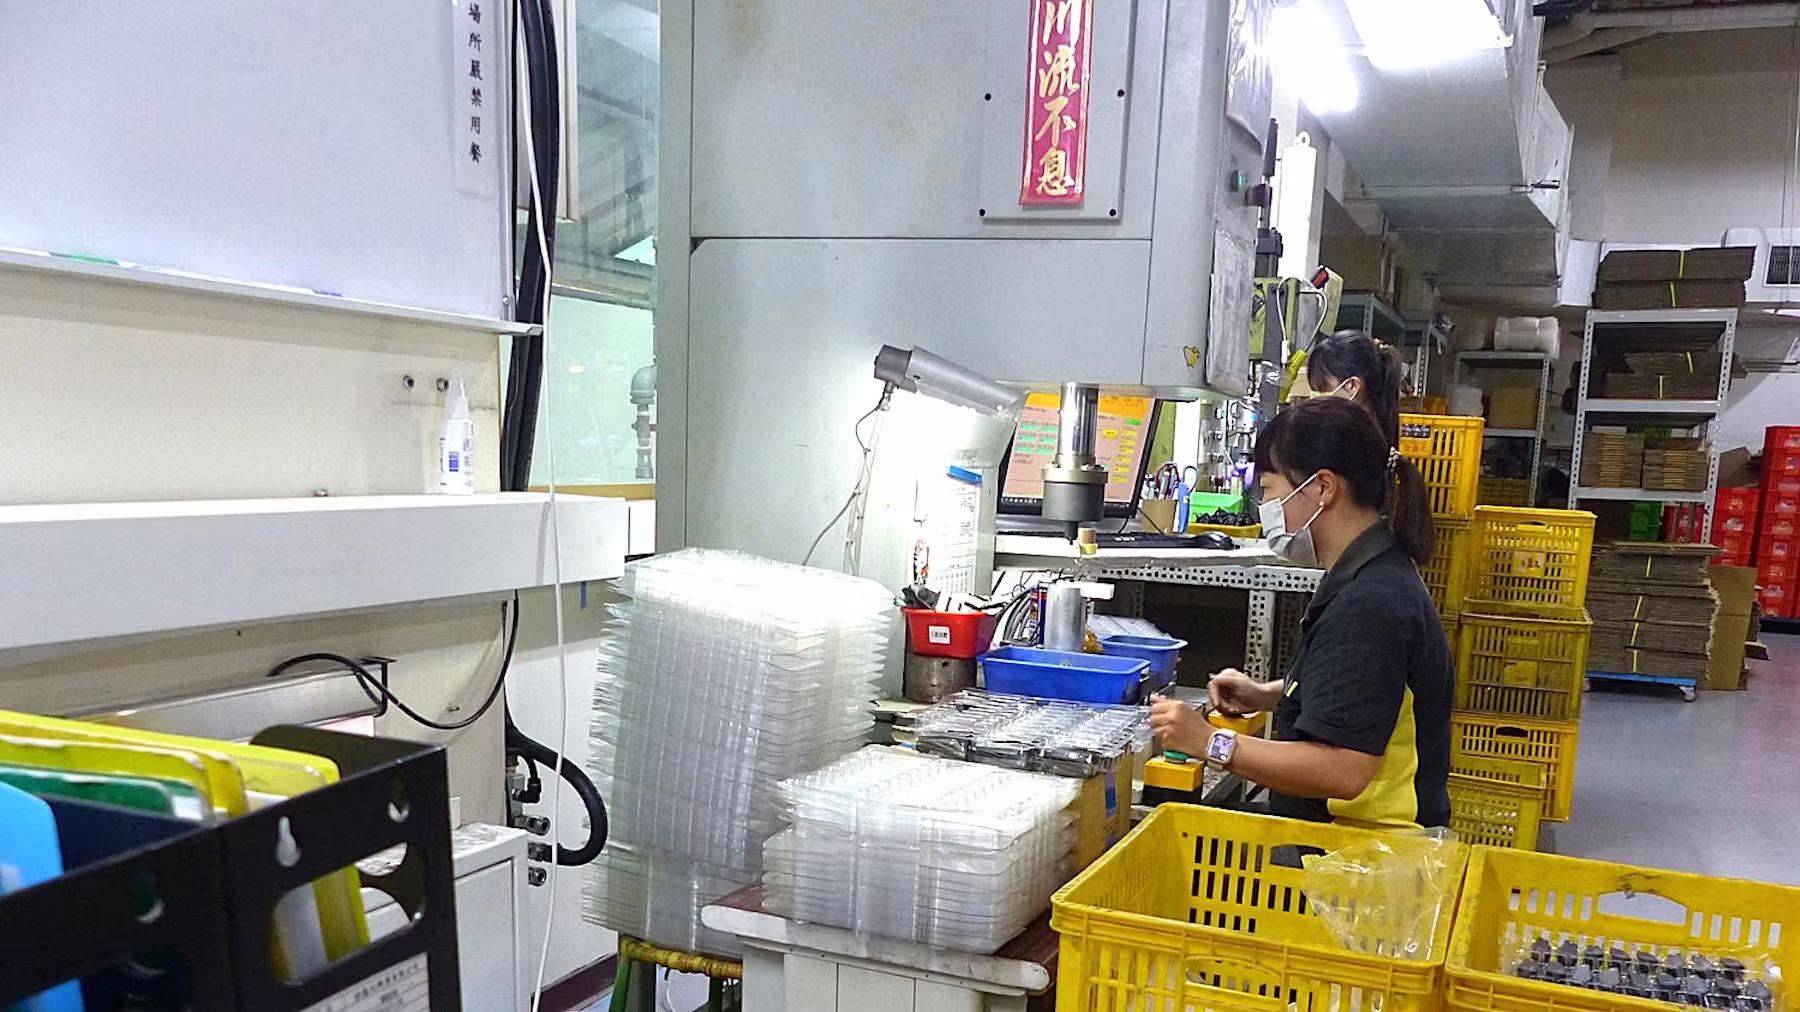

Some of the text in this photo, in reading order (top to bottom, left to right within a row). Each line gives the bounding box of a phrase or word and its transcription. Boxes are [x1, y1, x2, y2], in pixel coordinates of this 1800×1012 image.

[468, 2, 482, 163] 場所嚴禁用餐
[1035, 0, 1081, 196] 川流不息
